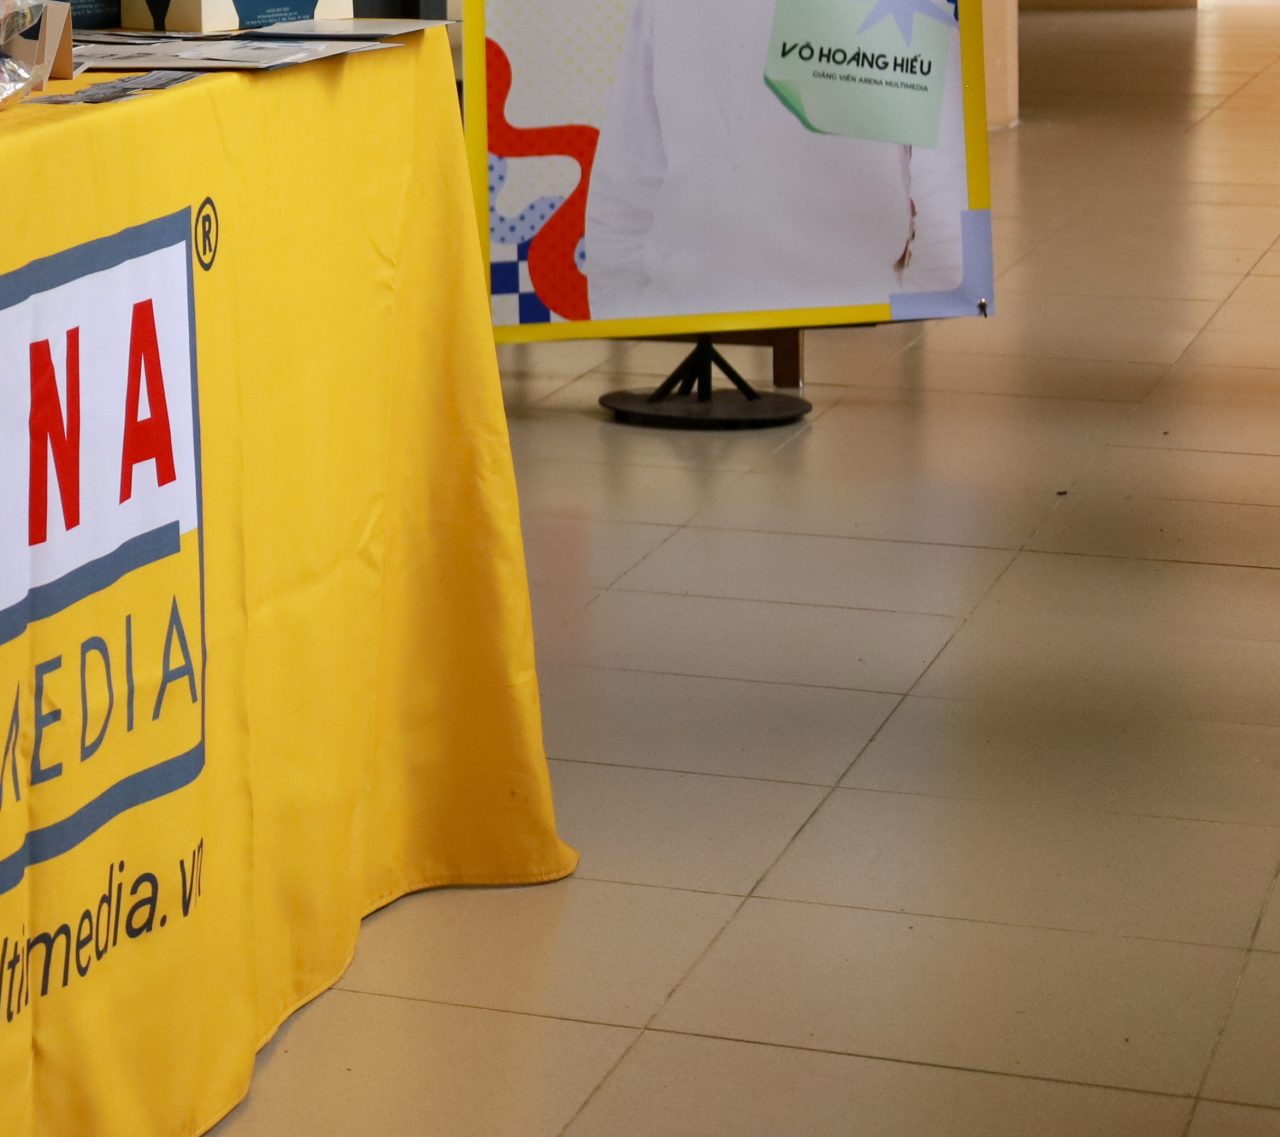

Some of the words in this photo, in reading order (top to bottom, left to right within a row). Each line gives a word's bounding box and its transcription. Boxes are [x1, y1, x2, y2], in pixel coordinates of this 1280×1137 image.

[818, 46, 889, 71] HOÀNG
[858, 76, 884, 87] ARENA
[885, 80, 929, 92] MULTIMEDIA
